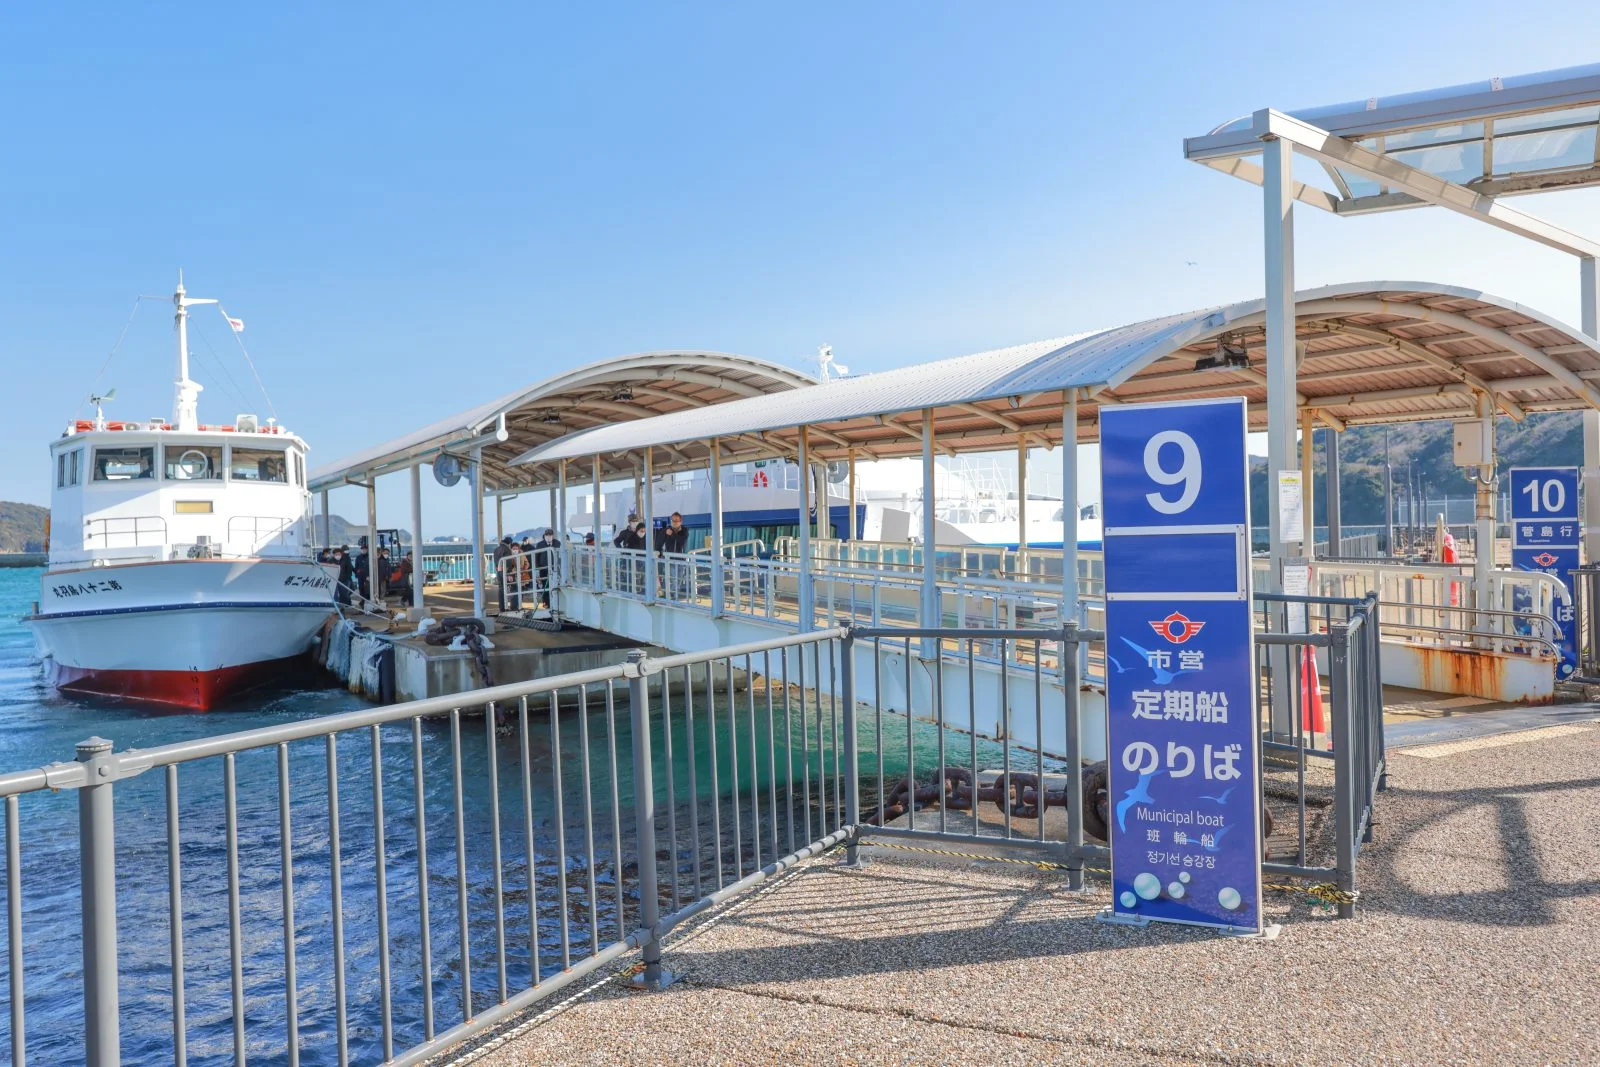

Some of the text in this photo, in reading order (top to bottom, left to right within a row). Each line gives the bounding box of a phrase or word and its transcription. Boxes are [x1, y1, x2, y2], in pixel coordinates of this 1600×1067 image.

[1143, 429, 1203, 515] 9
[1522, 478, 1566, 513] 10
[1146, 649, 1205, 671] 市営
[1131, 689, 1229, 724] 定期船
[1121, 741, 1243, 781] のりば
[1136, 806, 1225, 827] Municipal boat
[1147, 850, 1217, 869] 정기선 승강장
